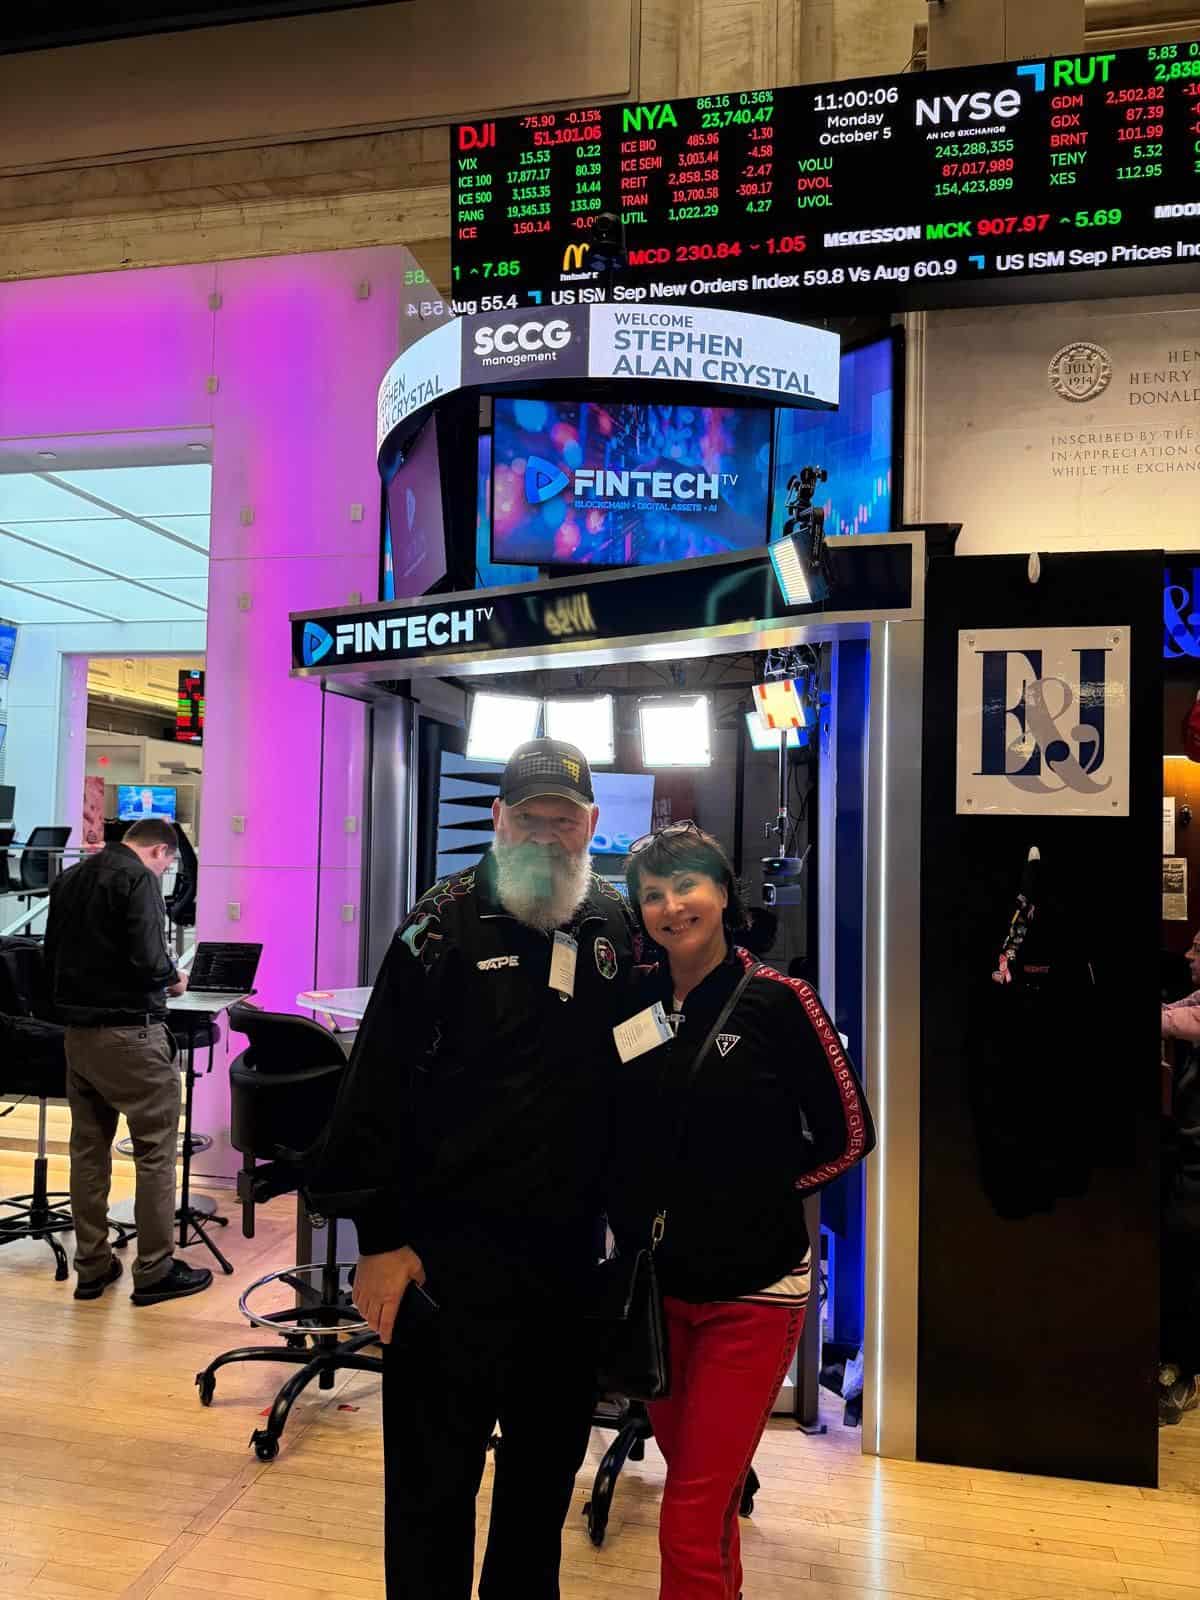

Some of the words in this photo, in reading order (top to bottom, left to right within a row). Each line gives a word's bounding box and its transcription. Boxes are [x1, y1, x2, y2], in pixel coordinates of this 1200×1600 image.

[1148, 45, 1178, 61] 5.83
[1054, 54, 1116, 87] RUT
[696, 95, 730, 110] 86.16
[739, 91, 774, 105] 0.36%
[814, 87, 898, 111] 11:00:06
[1051, 95, 1084, 109] GDM
[1106, 86, 1165, 104] 2,502.82
[520, 115, 556, 128] -75.90
[564, 110, 601, 125] -0.15%
[623, 103, 678, 132] NYA
[702, 106, 774, 128] 23,740.47
[827, 112, 884, 129] Monday
[1051, 113, 1080, 128] GDX
[1126, 105, 1164, 121] 87.39
[458, 122, 497, 150] DJI
[621, 141, 637, 153] ICE
[640, 139, 656, 151] BIO
[687, 132, 719, 147] 485.96
[748, 127, 773, 140] -1.30
[819, 130, 879, 145] October
[883, 127, 892, 139] 5
[1050, 132, 1088, 147] BRNT
[1117, 125, 1164, 141] 101.99
[458, 157, 478, 171] VIX
[519, 150, 550, 165] 15.53
[576, 145, 600, 158] 0.22
[621, 159, 637, 172] ICE
[639, 156, 662, 170] SEMI
[798, 156, 833, 172] VOLU
[935, 139, 1014, 159] 243,288,355
[1050, 151, 1087, 167] TENY
[1133, 144, 1163, 159] 5.32
[458, 176, 473, 188] ICE
[476, 174, 492, 186] 100
[576, 163, 600, 177] 80.39
[621, 176, 648, 189] REIT
[668, 169, 719, 186] 2,858.58
[741, 164, 773, 178] -2.47
[797, 176, 833, 191] DVOL
[942, 158, 1014, 177] 87,017,989
[1049, 172, 1077, 186] XES
[1116, 163, 1162, 180] 112.95
[458, 193, 473, 205] ICE
[475, 191, 492, 204] 500
[576, 181, 600, 194] 14.44
[621, 194, 648, 207] TRAN
[797, 194, 833, 209] UVOL
[935, 177, 1014, 197] 154,423,899
[458, 209, 484, 222] FANG
[570, 198, 601, 213] 133.69
[621, 211, 648, 225] UTIL
[668, 204, 719, 221] 1,022.29
[746, 199, 772, 213] 4.27
[459, 227, 477, 240] ICE
[513, 220, 550, 235] 150.14
[628, 248, 671, 266] MCD
[676, 241, 742, 262] 230.84
[766, 235, 806, 255] 1.05
[926, 221, 972, 240] MCK
[977, 213, 1050, 236] 907.97
[1075, 208, 1122, 228] 5.69
[481, 294, 518, 311] 55.4
[551, 290, 575, 305] US
[613, 285, 647, 302] Sep
[650, 282, 687, 298] New
[690, 277, 749, 296] Orders
[752, 273, 800, 290] Index
[803, 268, 845, 286] 59.8
[848, 266, 872, 282] Vs
[874, 264, 910, 282] Aug
[914, 258, 958, 277] 60.9
[996, 254, 1024, 271] US
[1028, 250, 1065, 268] ISM
[1069, 249, 1108, 267] Sep
[1112, 244, 1172, 262] Prices
[483, 260, 521, 278] 7.85
[614, 312, 693, 328] WELCOME
[473, 319, 572, 356] SCCG
[614, 329, 743, 358] STEPHEN
[482, 351, 557, 367] management
[1064, 363, 1096, 375] JULY
[612, 354, 693, 378] ALAN
[702, 359, 816, 396] CRYSTAL
[1068, 376, 1092, 386] 1914
[1129, 369, 1192, 385] HENRY
[1051, 431, 1134, 445] INSCRIBED
[1140, 431, 1155, 441] BY
[1163, 429, 1193, 441] THE
[1052, 465, 1096, 477] WHILE
[1103, 464, 1129, 475] THE
[574, 469, 719, 500] FINTECH
[720, 473, 739, 486] TV
[336, 608, 474, 655] FINTECH
[475, 607, 494, 621] TV
